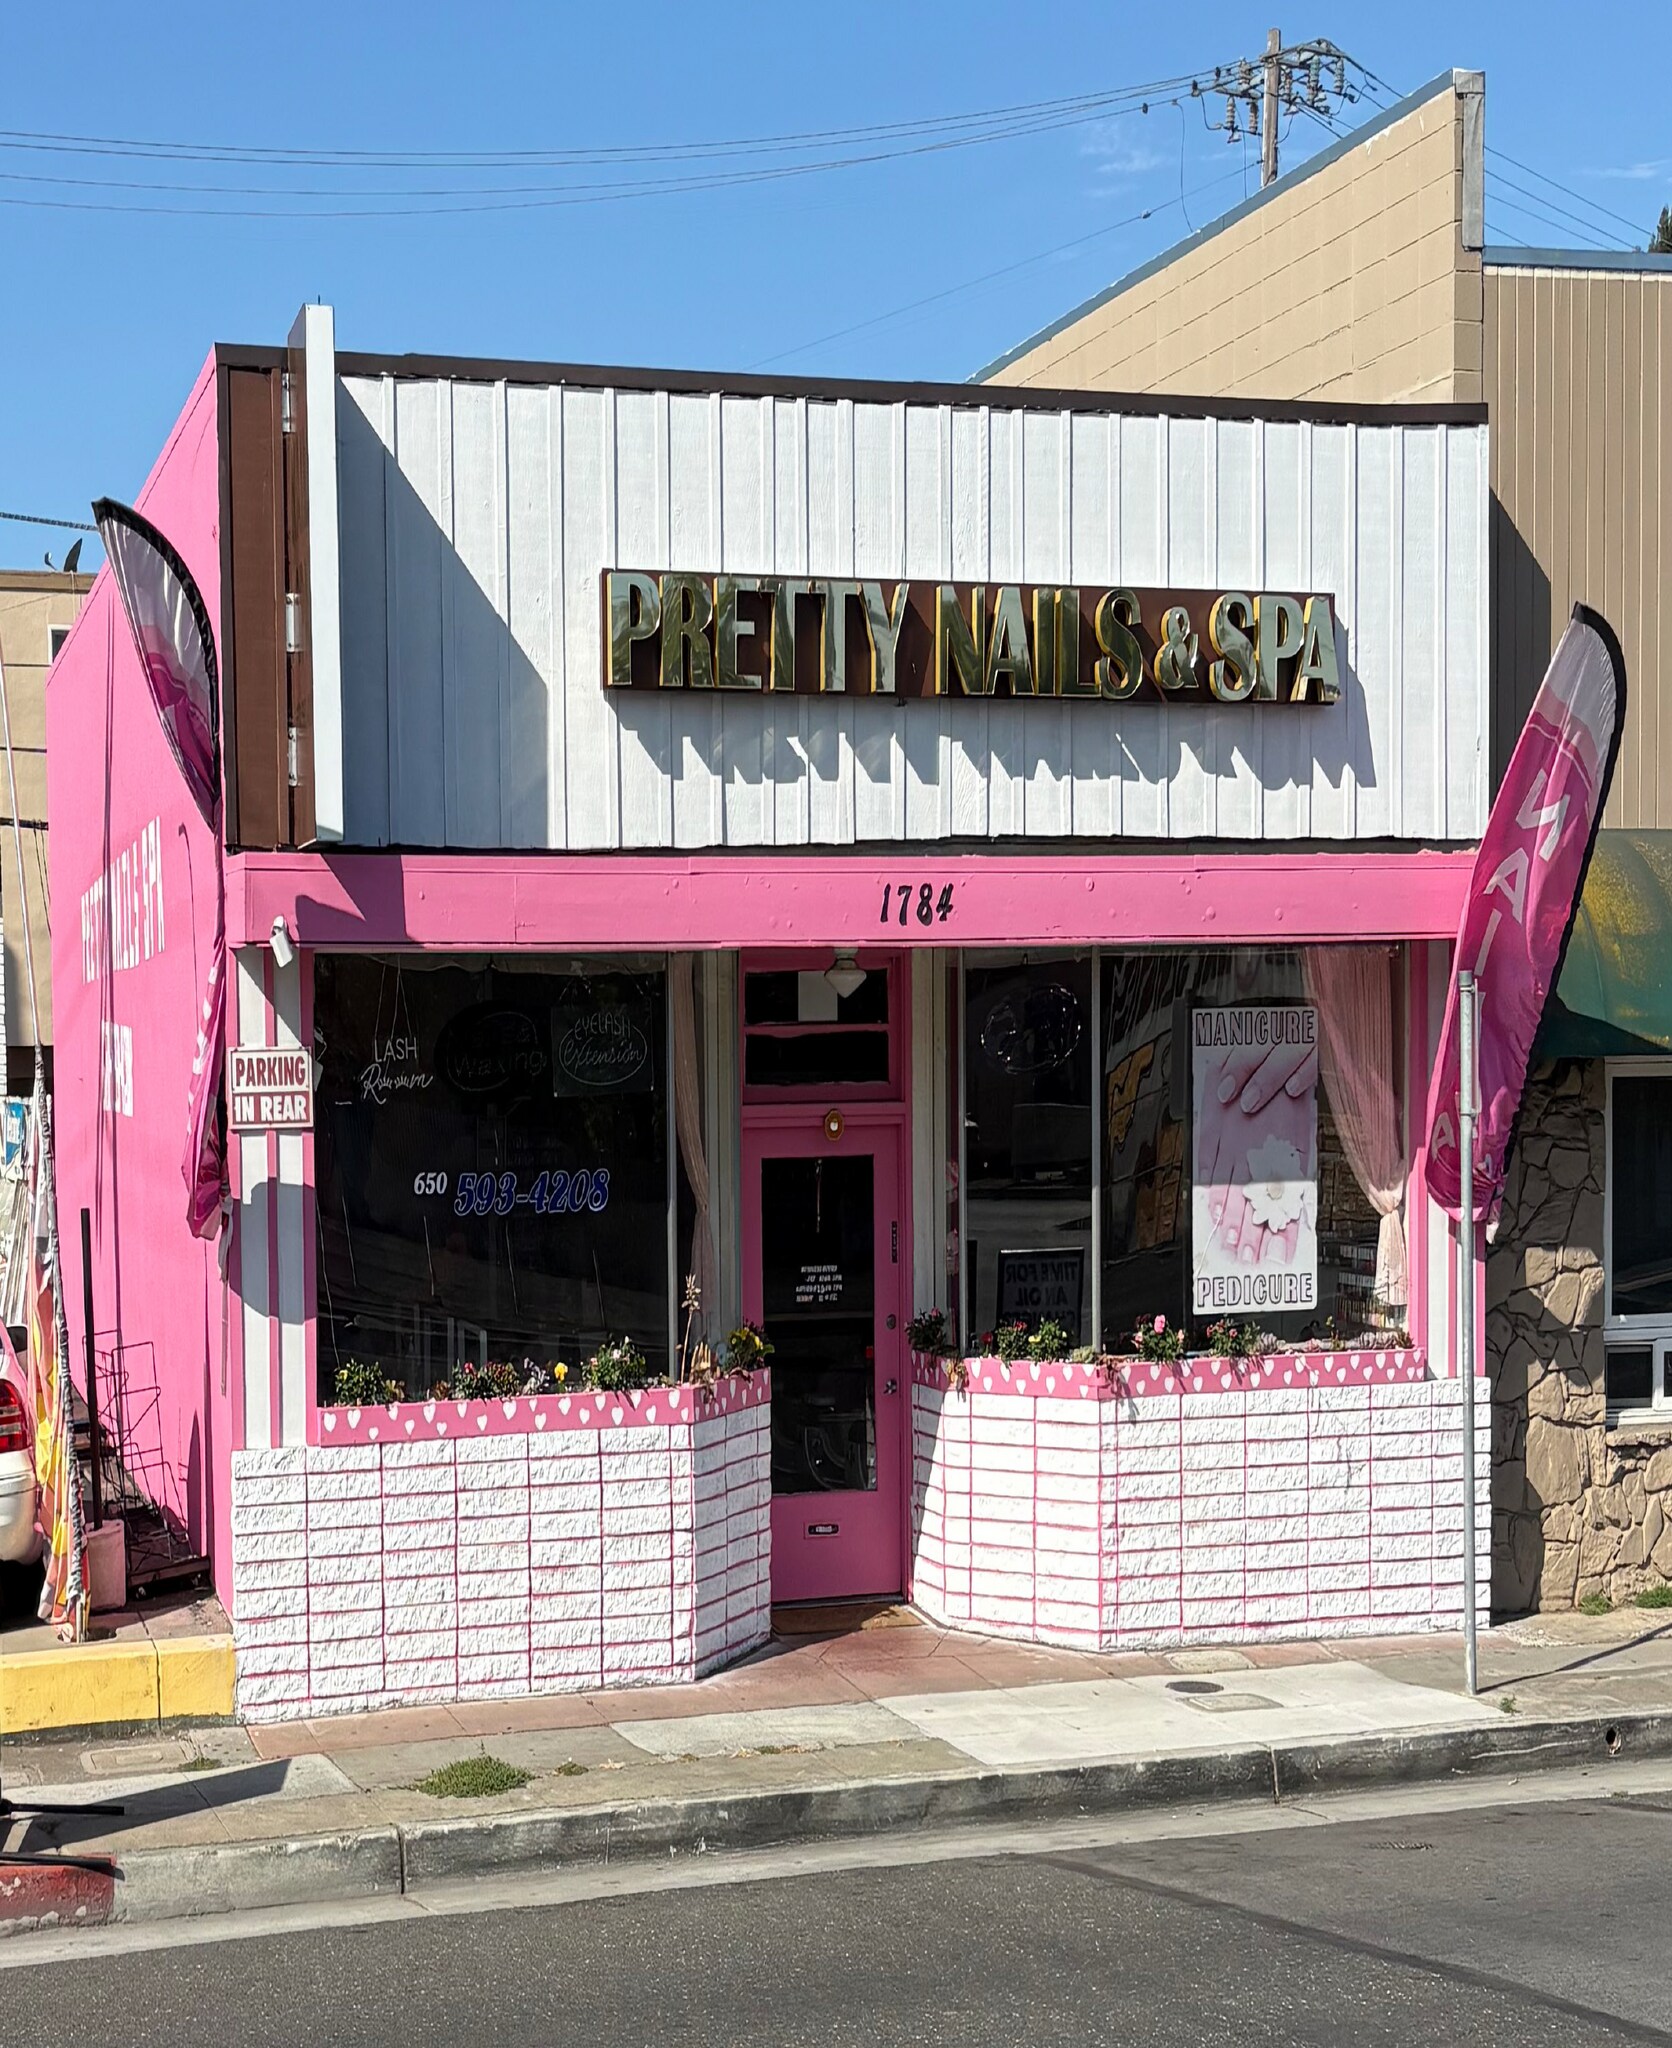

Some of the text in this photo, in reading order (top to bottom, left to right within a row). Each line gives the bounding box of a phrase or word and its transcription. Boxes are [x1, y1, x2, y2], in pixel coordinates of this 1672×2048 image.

[606, 573, 1341, 702] PRETTY NAILS & SPA
[141, 815, 165, 961] SPA
[880, 883, 954, 927] 1784
[1195, 1010, 1315, 1047] MANICURE
[374, 1037, 418, 1062] LASH
[235, 1056, 306, 1087] PARKING
[235, 1095, 307, 1122] IN REAR
[413, 1168, 610, 1216] 650 593-4208
[1197, 1273, 1313, 1308] PEDICURE
